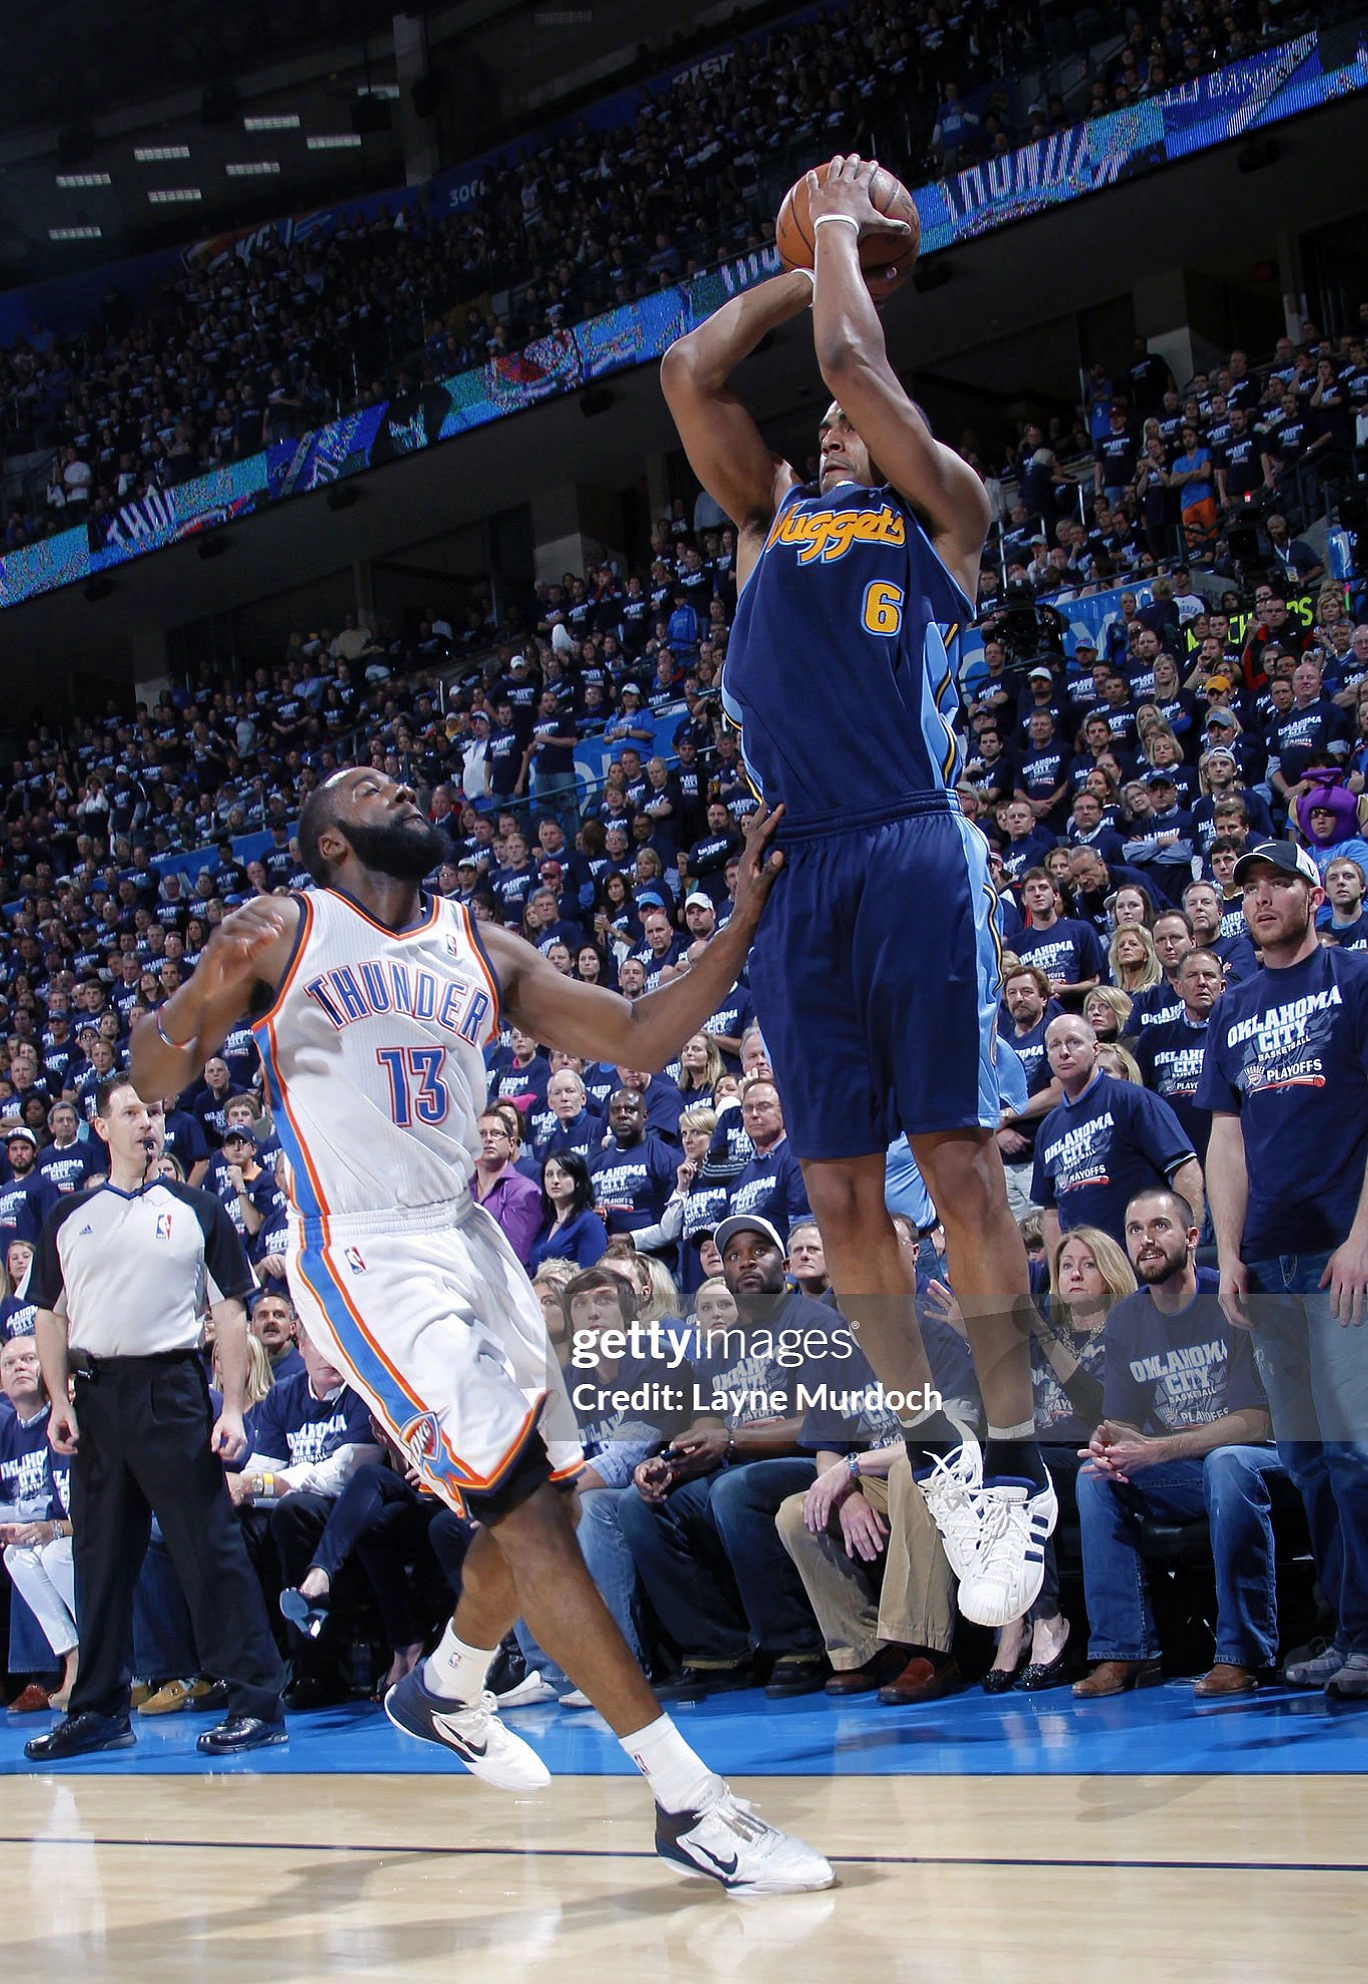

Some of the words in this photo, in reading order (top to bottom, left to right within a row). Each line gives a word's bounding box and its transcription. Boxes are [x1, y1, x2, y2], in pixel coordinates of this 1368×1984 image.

[765, 500, 906, 566] Nuggets
[861, 579, 905, 637] 6
[303, 960, 491, 1047] THUNDER
[1227, 984, 1343, 1048] OKLAHOMA
[1258, 1015, 1308, 1052] CITY
[1258, 1034, 1311, 1062] BASKETBALL
[376, 1045, 450, 1129] 13
[1266, 1058, 1323, 1082] PLAYOFFS
[1044, 1111, 1115, 1165] OKLAHOMA
[1061, 1135, 1092, 1165] CITY
[601, 1175, 627, 1190] CITY
[1164, 1365, 1210, 1396] CITY
[292, 1438, 323, 1456] CITY
